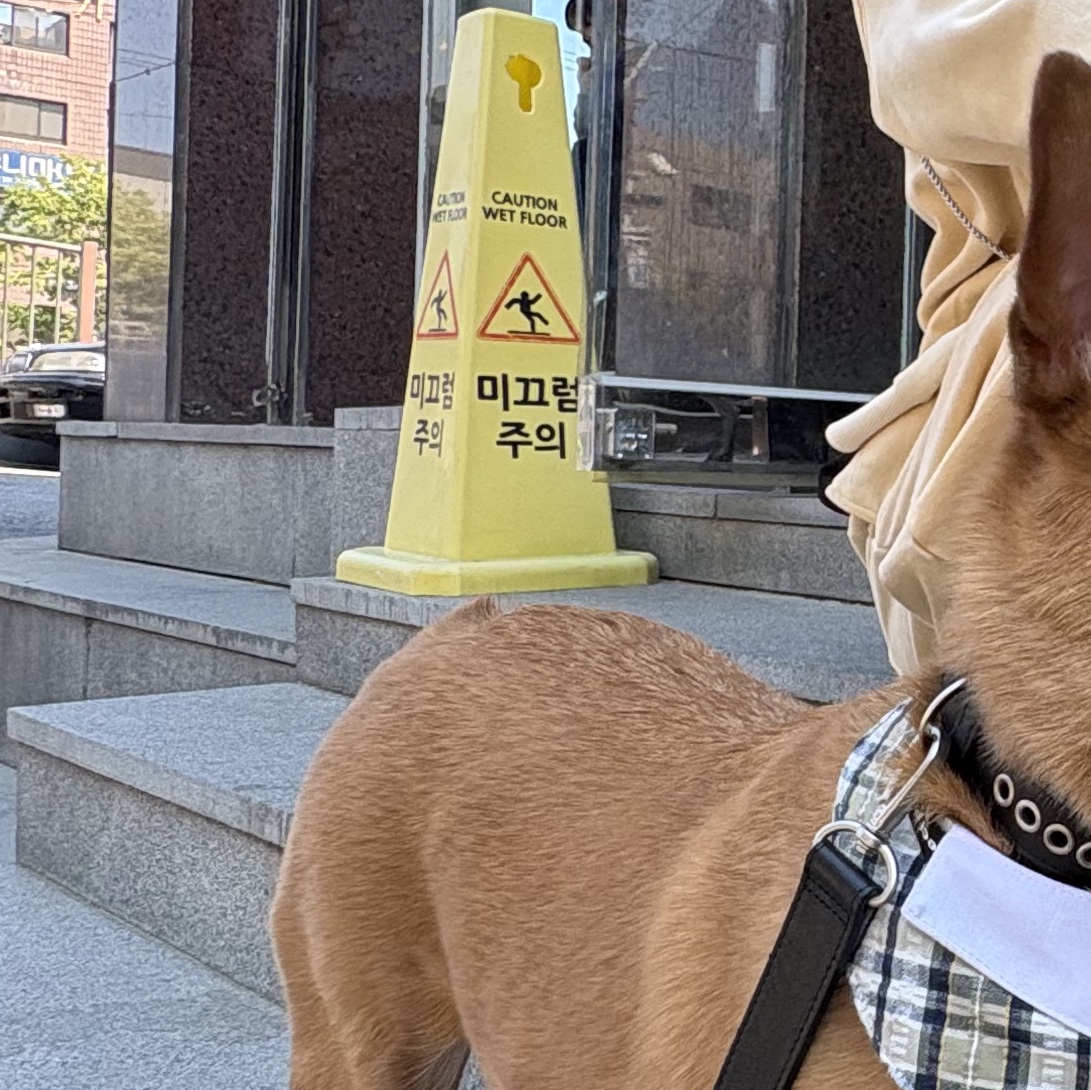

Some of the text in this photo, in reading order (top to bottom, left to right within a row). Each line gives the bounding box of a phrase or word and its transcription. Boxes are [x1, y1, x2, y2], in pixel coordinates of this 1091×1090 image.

[437, 191, 466, 207] CAUTION
[491, 191, 558, 211] CAUTION
[432, 207, 468, 223] WET FLOOR
[482, 206, 568, 229] WET FLOOR
[410, 371, 456, 410] 미끄럼
[477, 373, 578, 413] 미끄럼
[413, 418, 444, 458] 주의
[496, 421, 566, 459] 주의
